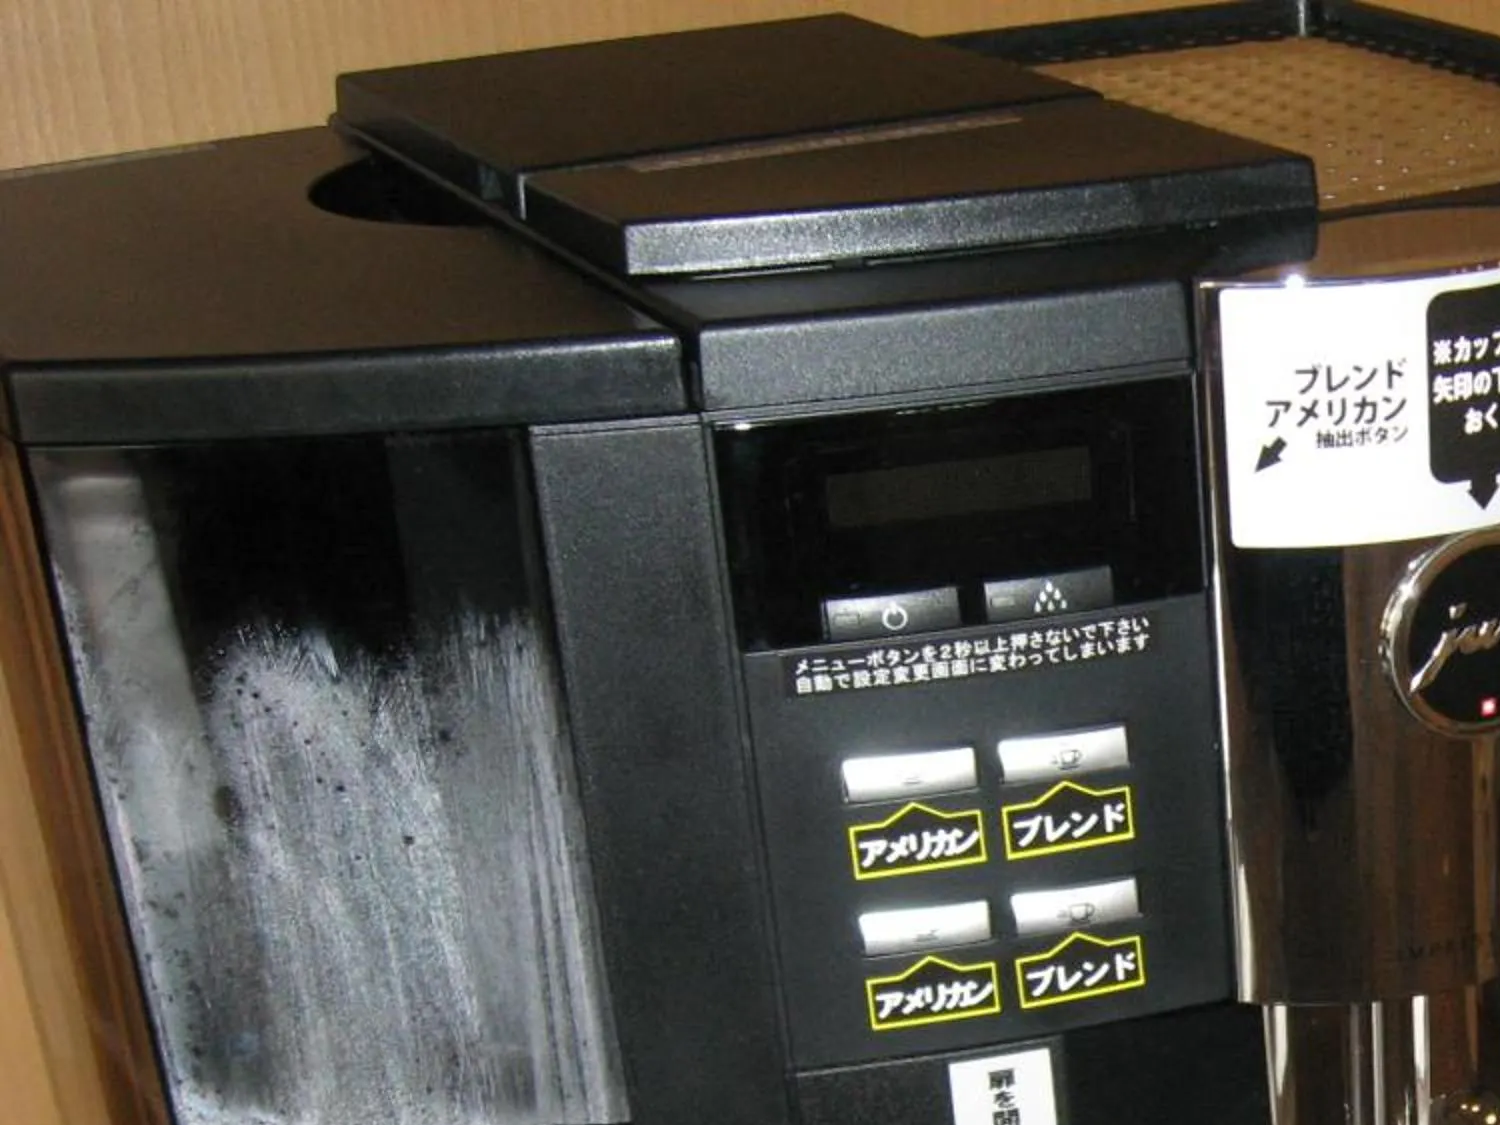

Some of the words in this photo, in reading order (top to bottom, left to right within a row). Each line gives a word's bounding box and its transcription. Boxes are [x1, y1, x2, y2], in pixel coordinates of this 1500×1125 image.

[1295, 358, 1407, 396] ブレンド
[1266, 395, 1407, 429] アメリカン
[1464, 402, 1499, 435] おく
[1316, 426, 1409, 450] 抽出ボタン
[1012, 803, 1126, 848] ブレンド
[858, 828, 980, 868] アメリカン
[1026, 952, 1137, 998] ブレンド
[876, 981, 995, 1019] アメリカン
